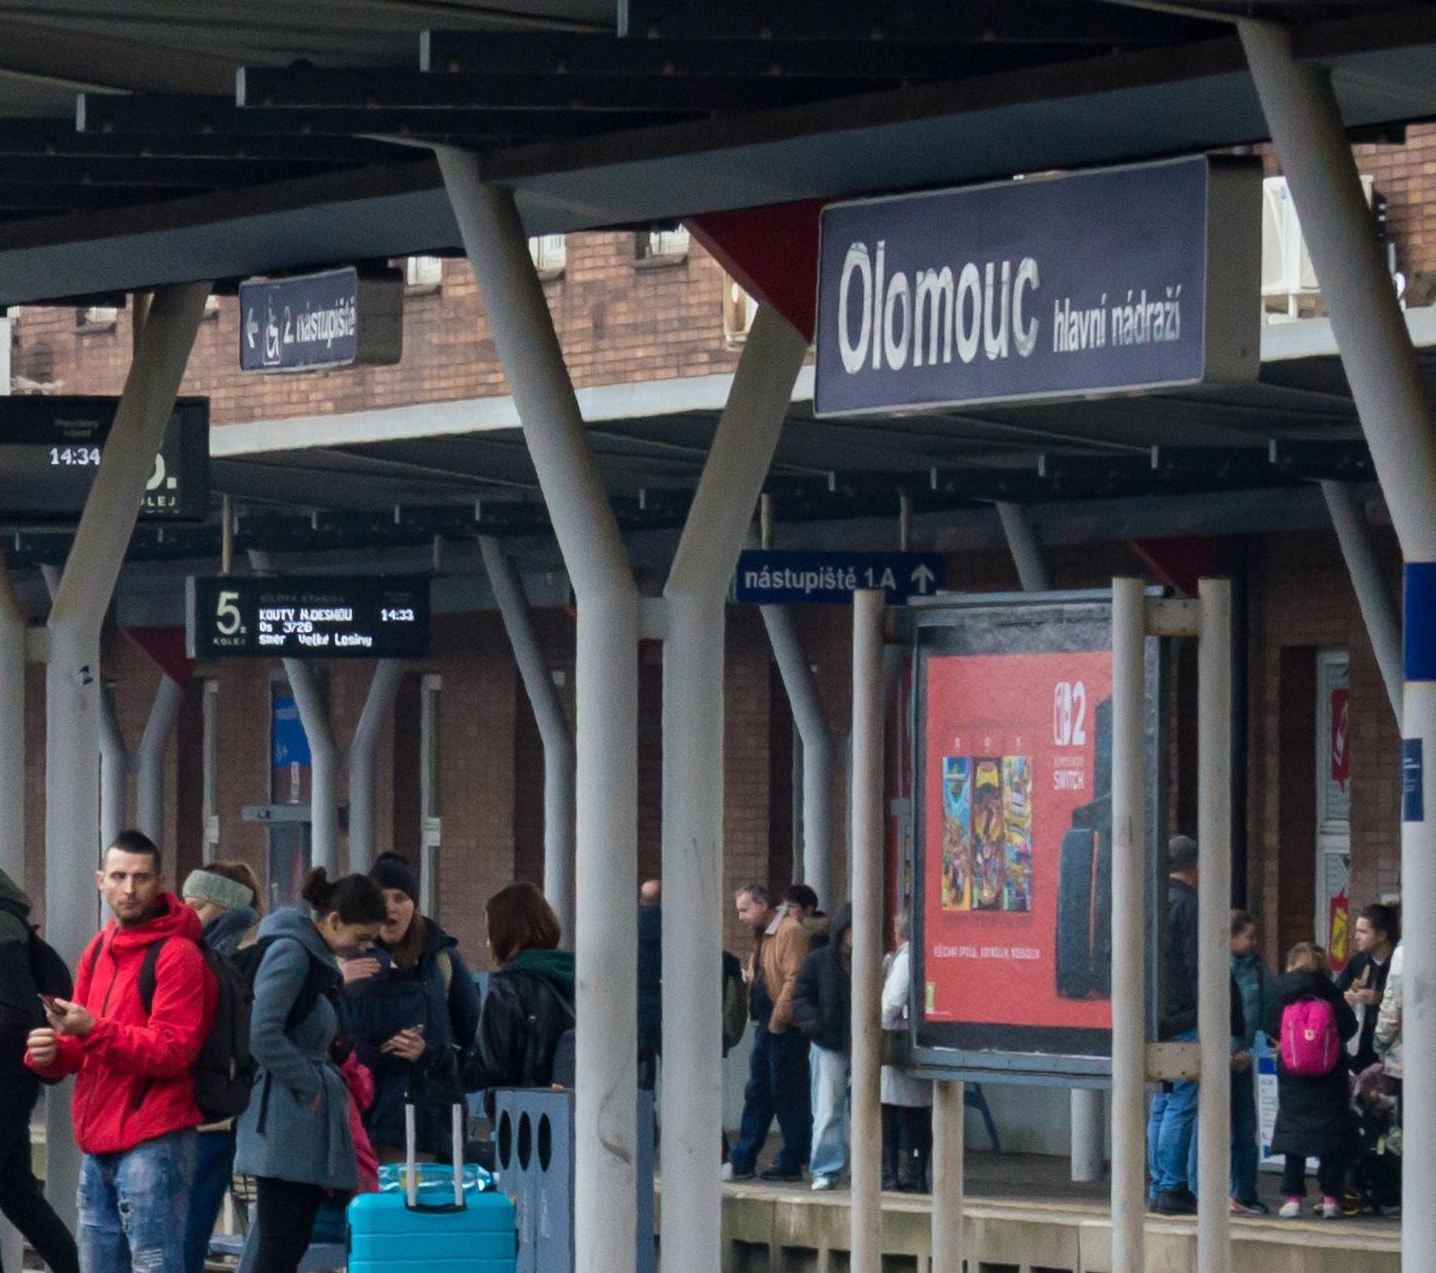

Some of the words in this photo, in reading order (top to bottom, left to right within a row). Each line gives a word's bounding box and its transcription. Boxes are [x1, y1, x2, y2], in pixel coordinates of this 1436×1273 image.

[838, 240, 1039, 374] Olomouc
[1053, 293, 1106, 352] hlavní
[1112, 285, 1182, 346] nádraží
[296, 296, 356, 349] nástupiště
[50, 448, 101, 465] 14:34
[744, 564, 857, 594] nástupiště
[863, 566, 897, 591] 1.A
[259, 608, 294, 622] KOUTY
[381, 609, 415, 622] 14:33
[1054, 770, 1085, 791] SWITCH
